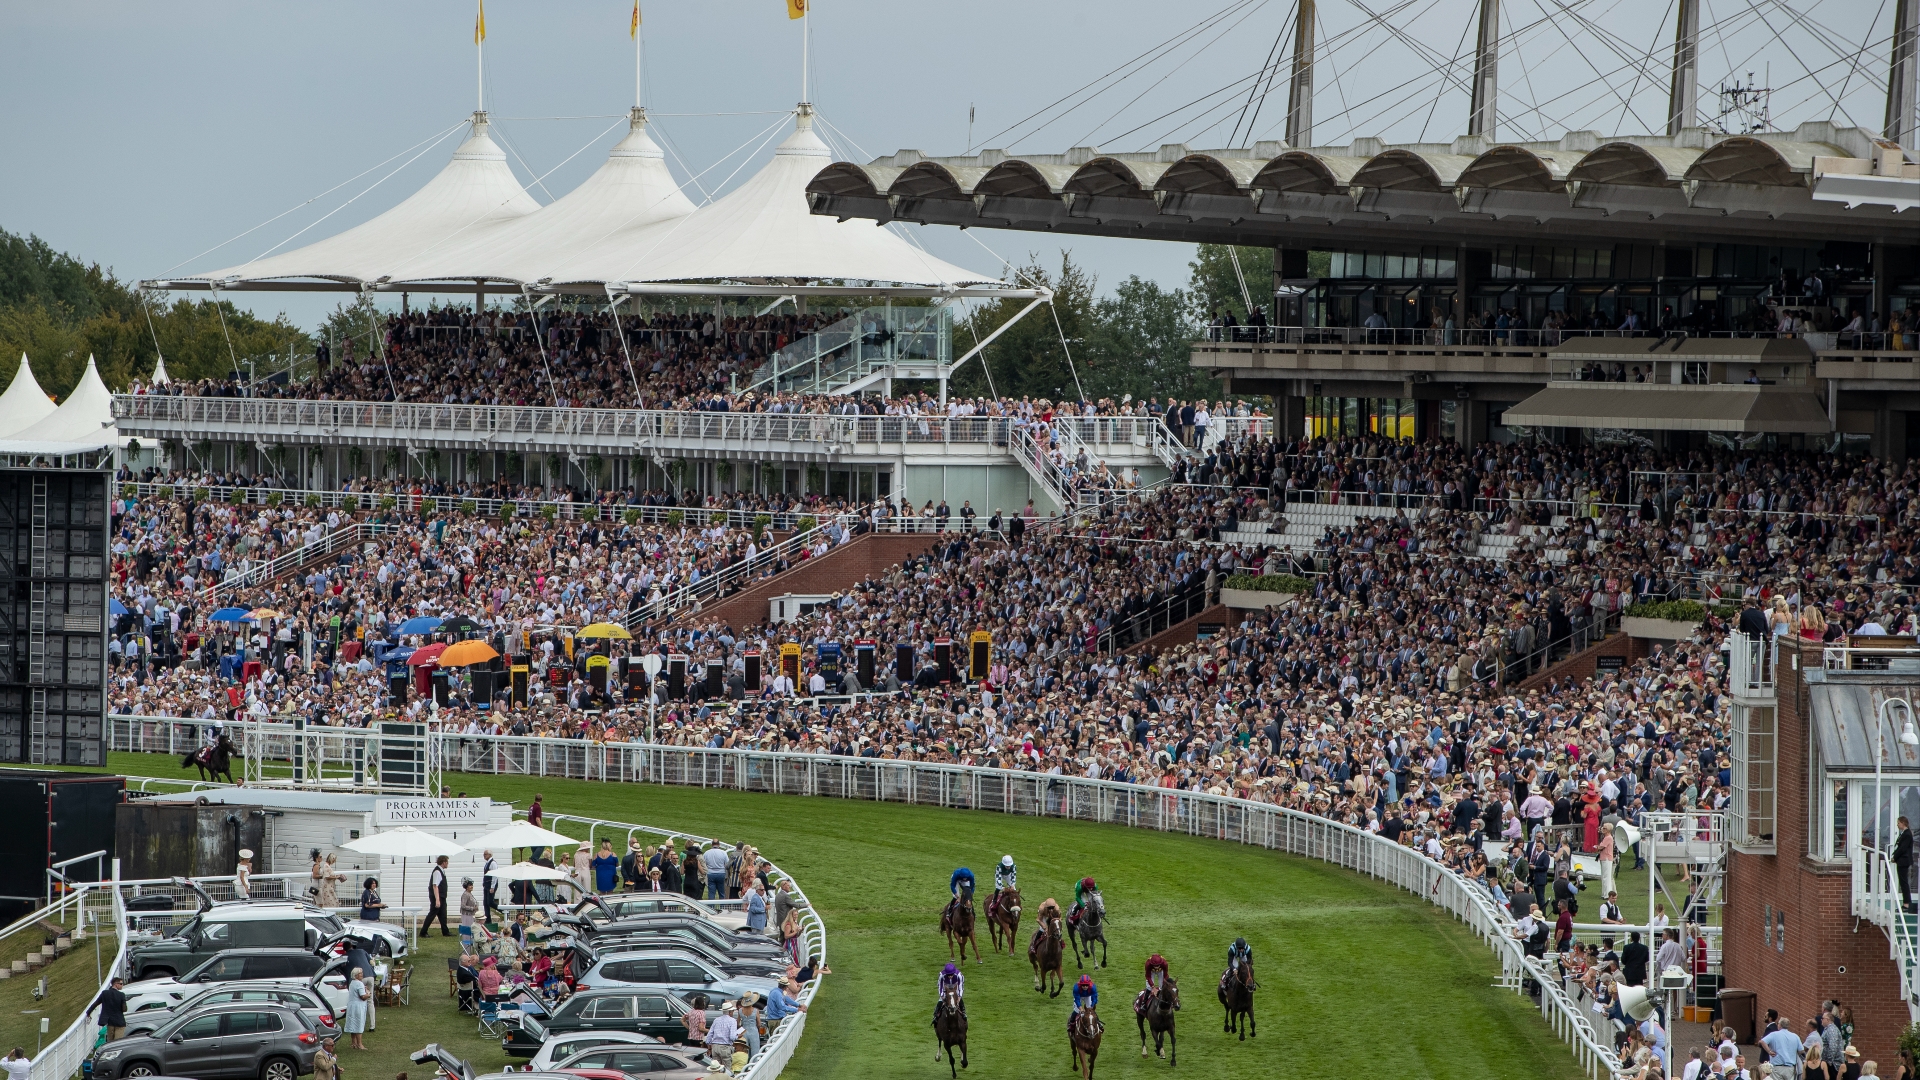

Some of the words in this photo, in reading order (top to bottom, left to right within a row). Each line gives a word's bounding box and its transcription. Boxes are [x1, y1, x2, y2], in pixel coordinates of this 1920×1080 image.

[386, 800, 469, 810] PROGRAMMES
[472, 800, 481, 809] &
[390, 810, 477, 820] INFORMATION
